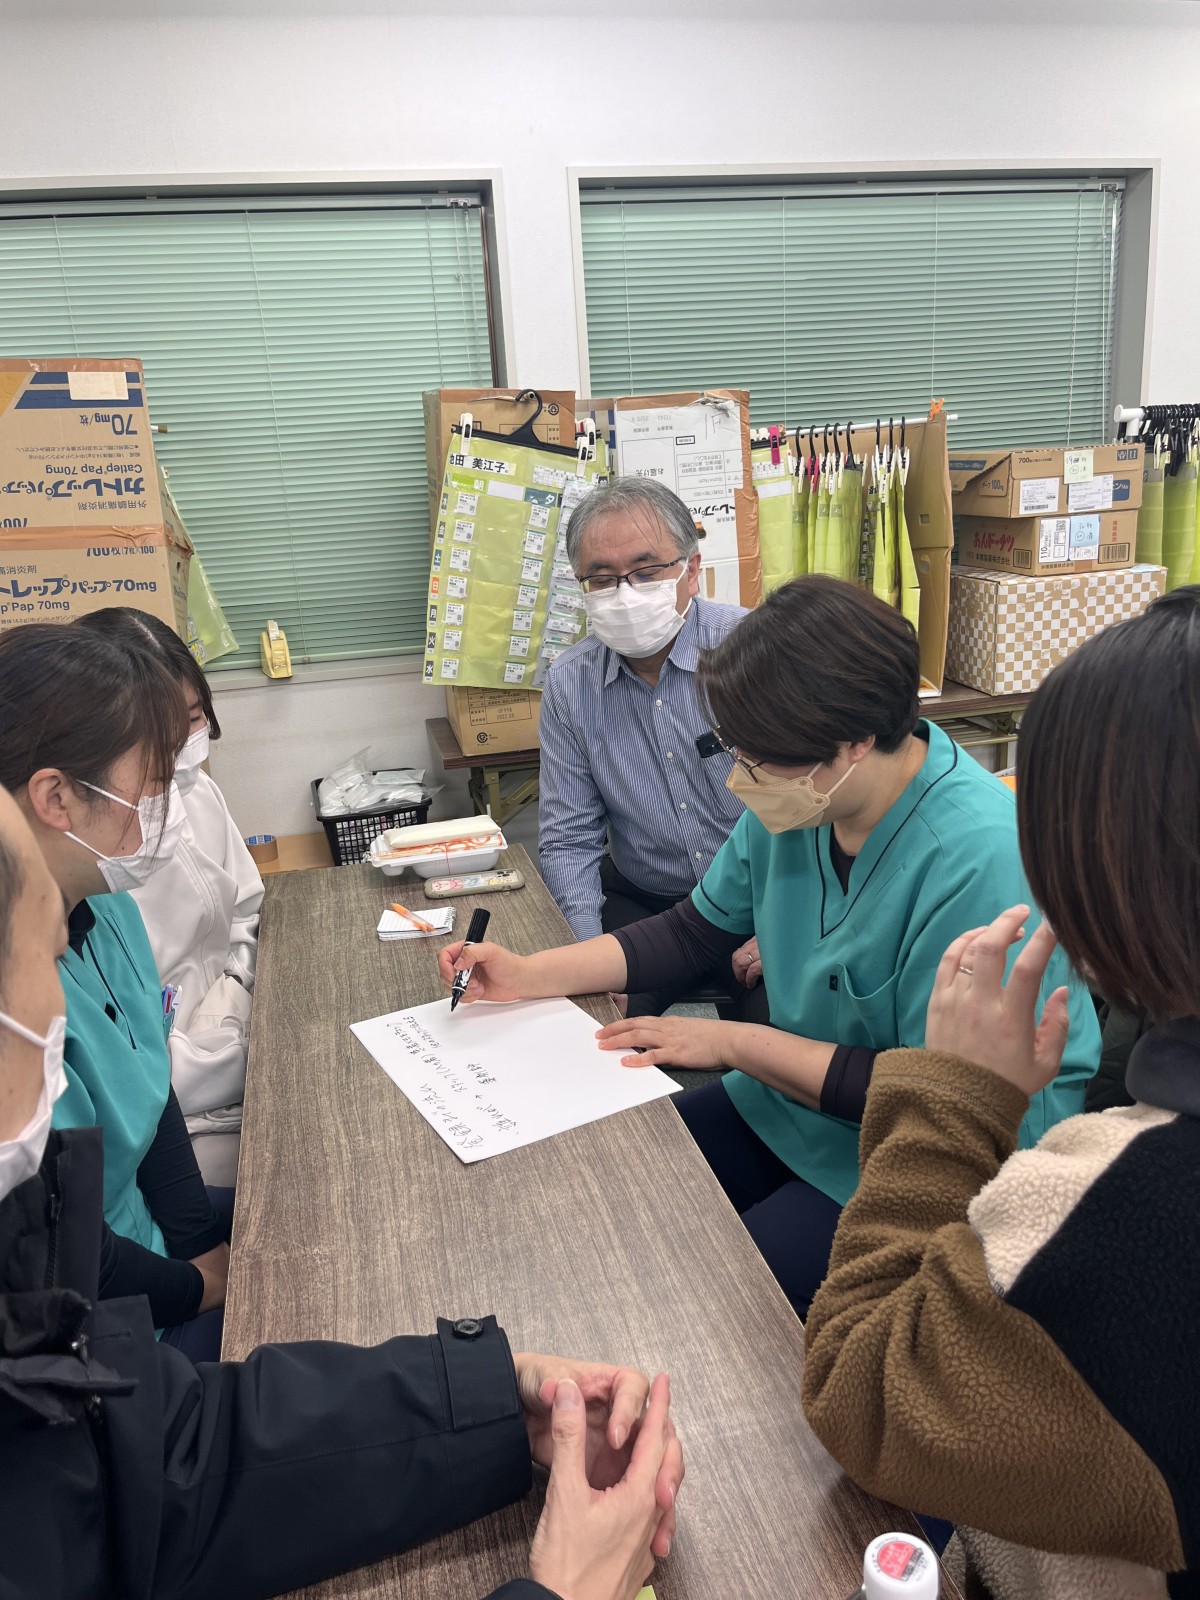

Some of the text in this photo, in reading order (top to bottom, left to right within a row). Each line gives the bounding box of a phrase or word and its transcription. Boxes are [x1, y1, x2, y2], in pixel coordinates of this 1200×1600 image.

[79, 413, 138, 436] 70mg/枚
[45, 465, 78, 476] 70mg
[81, 464, 103, 475] Pap
[472, 458, 506, 473] 美江子
[635, 468, 664, 477] お届け先
[2, 477, 145, 498] カトレップパップ
[77, 499, 147, 511] 外用鎮痛消炎剤
[11, 602, 35, 613] Pap
[37, 600, 70, 611] 70mg
